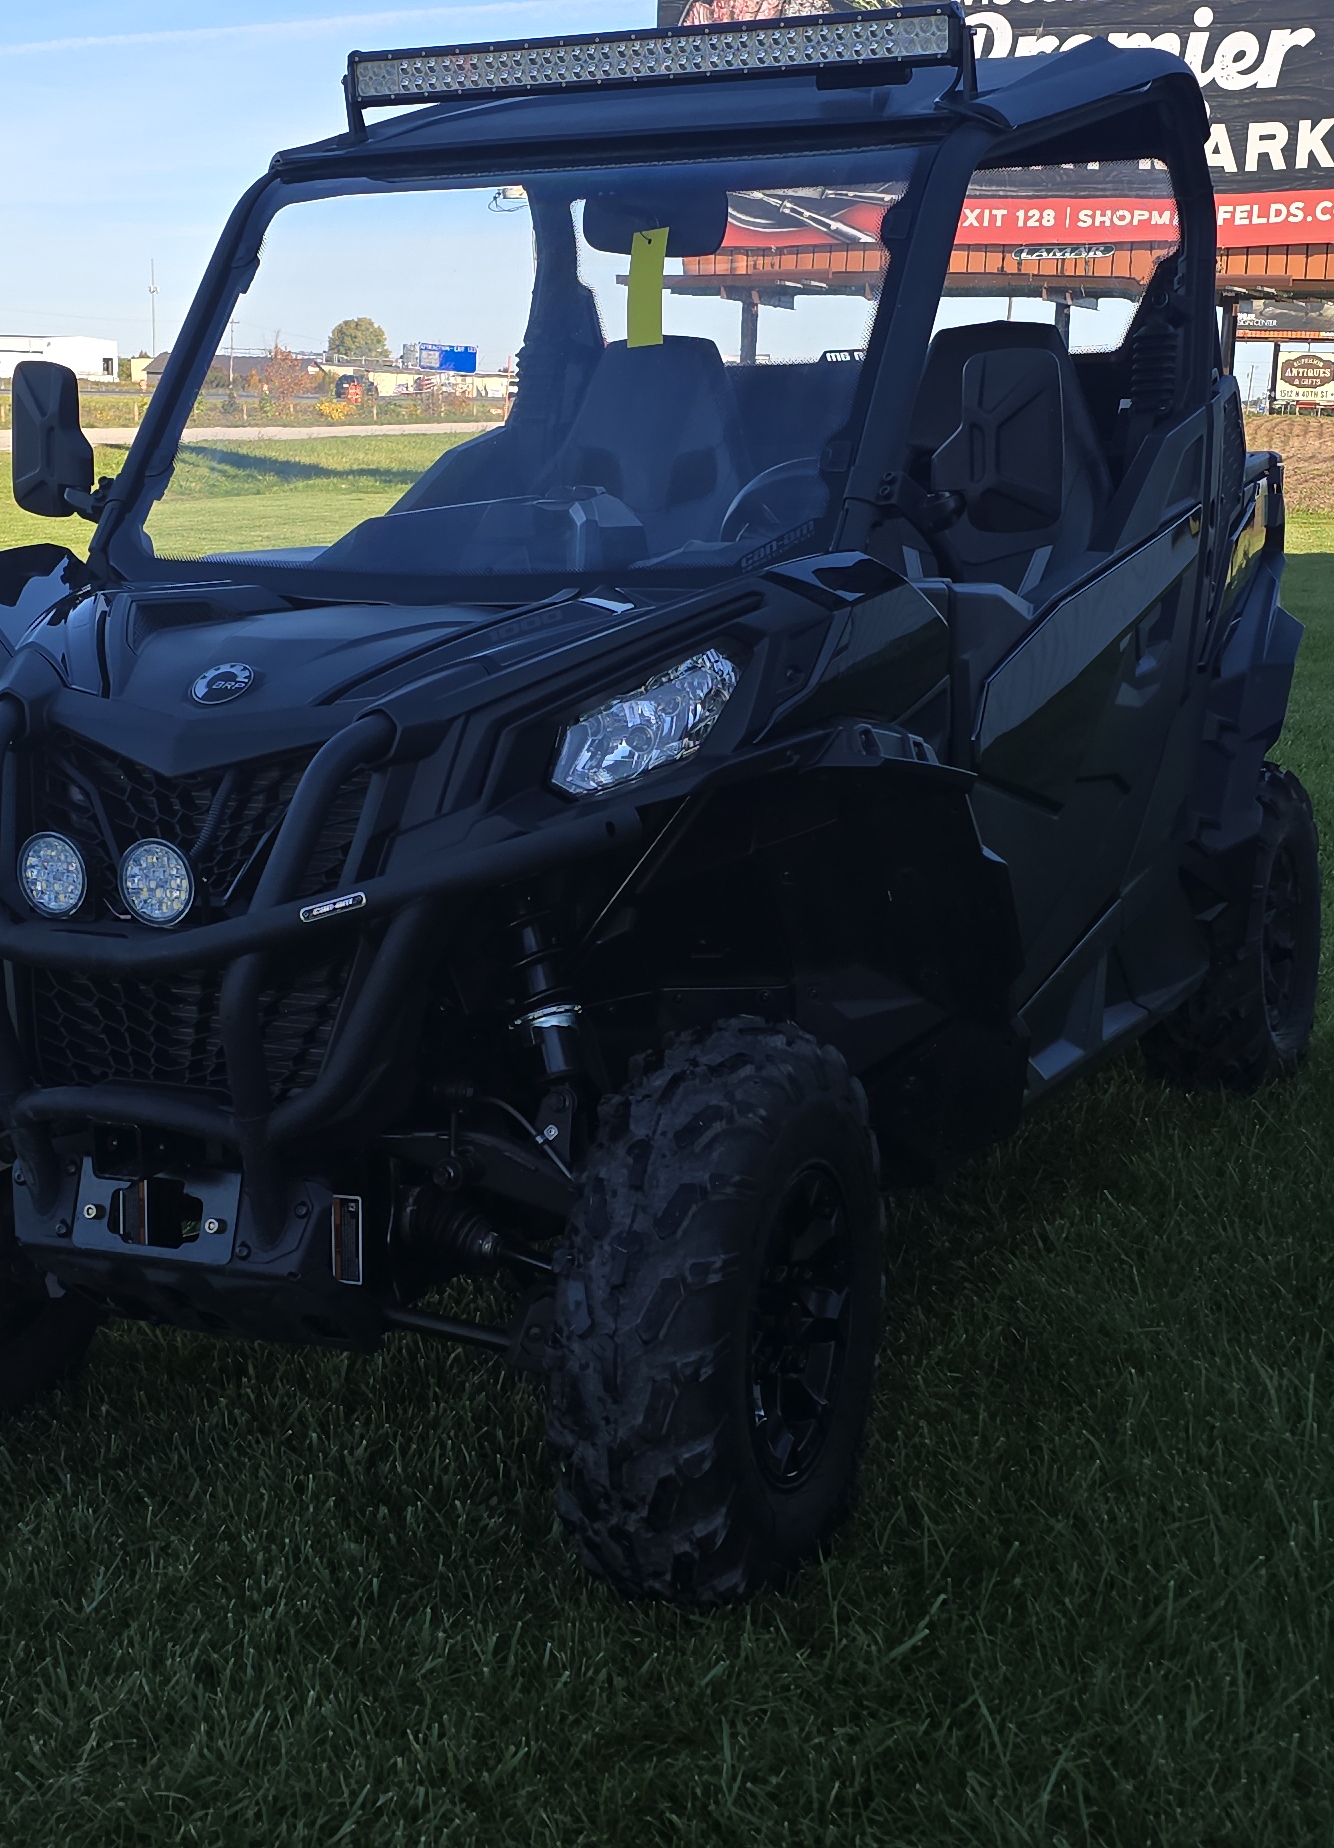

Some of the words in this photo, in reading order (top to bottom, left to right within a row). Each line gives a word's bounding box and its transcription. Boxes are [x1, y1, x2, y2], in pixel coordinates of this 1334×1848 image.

[962, 208, 1007, 228] XIT
[1015, 208, 1056, 228] 128
[1284, 368, 1331, 378] ANTIQUES
